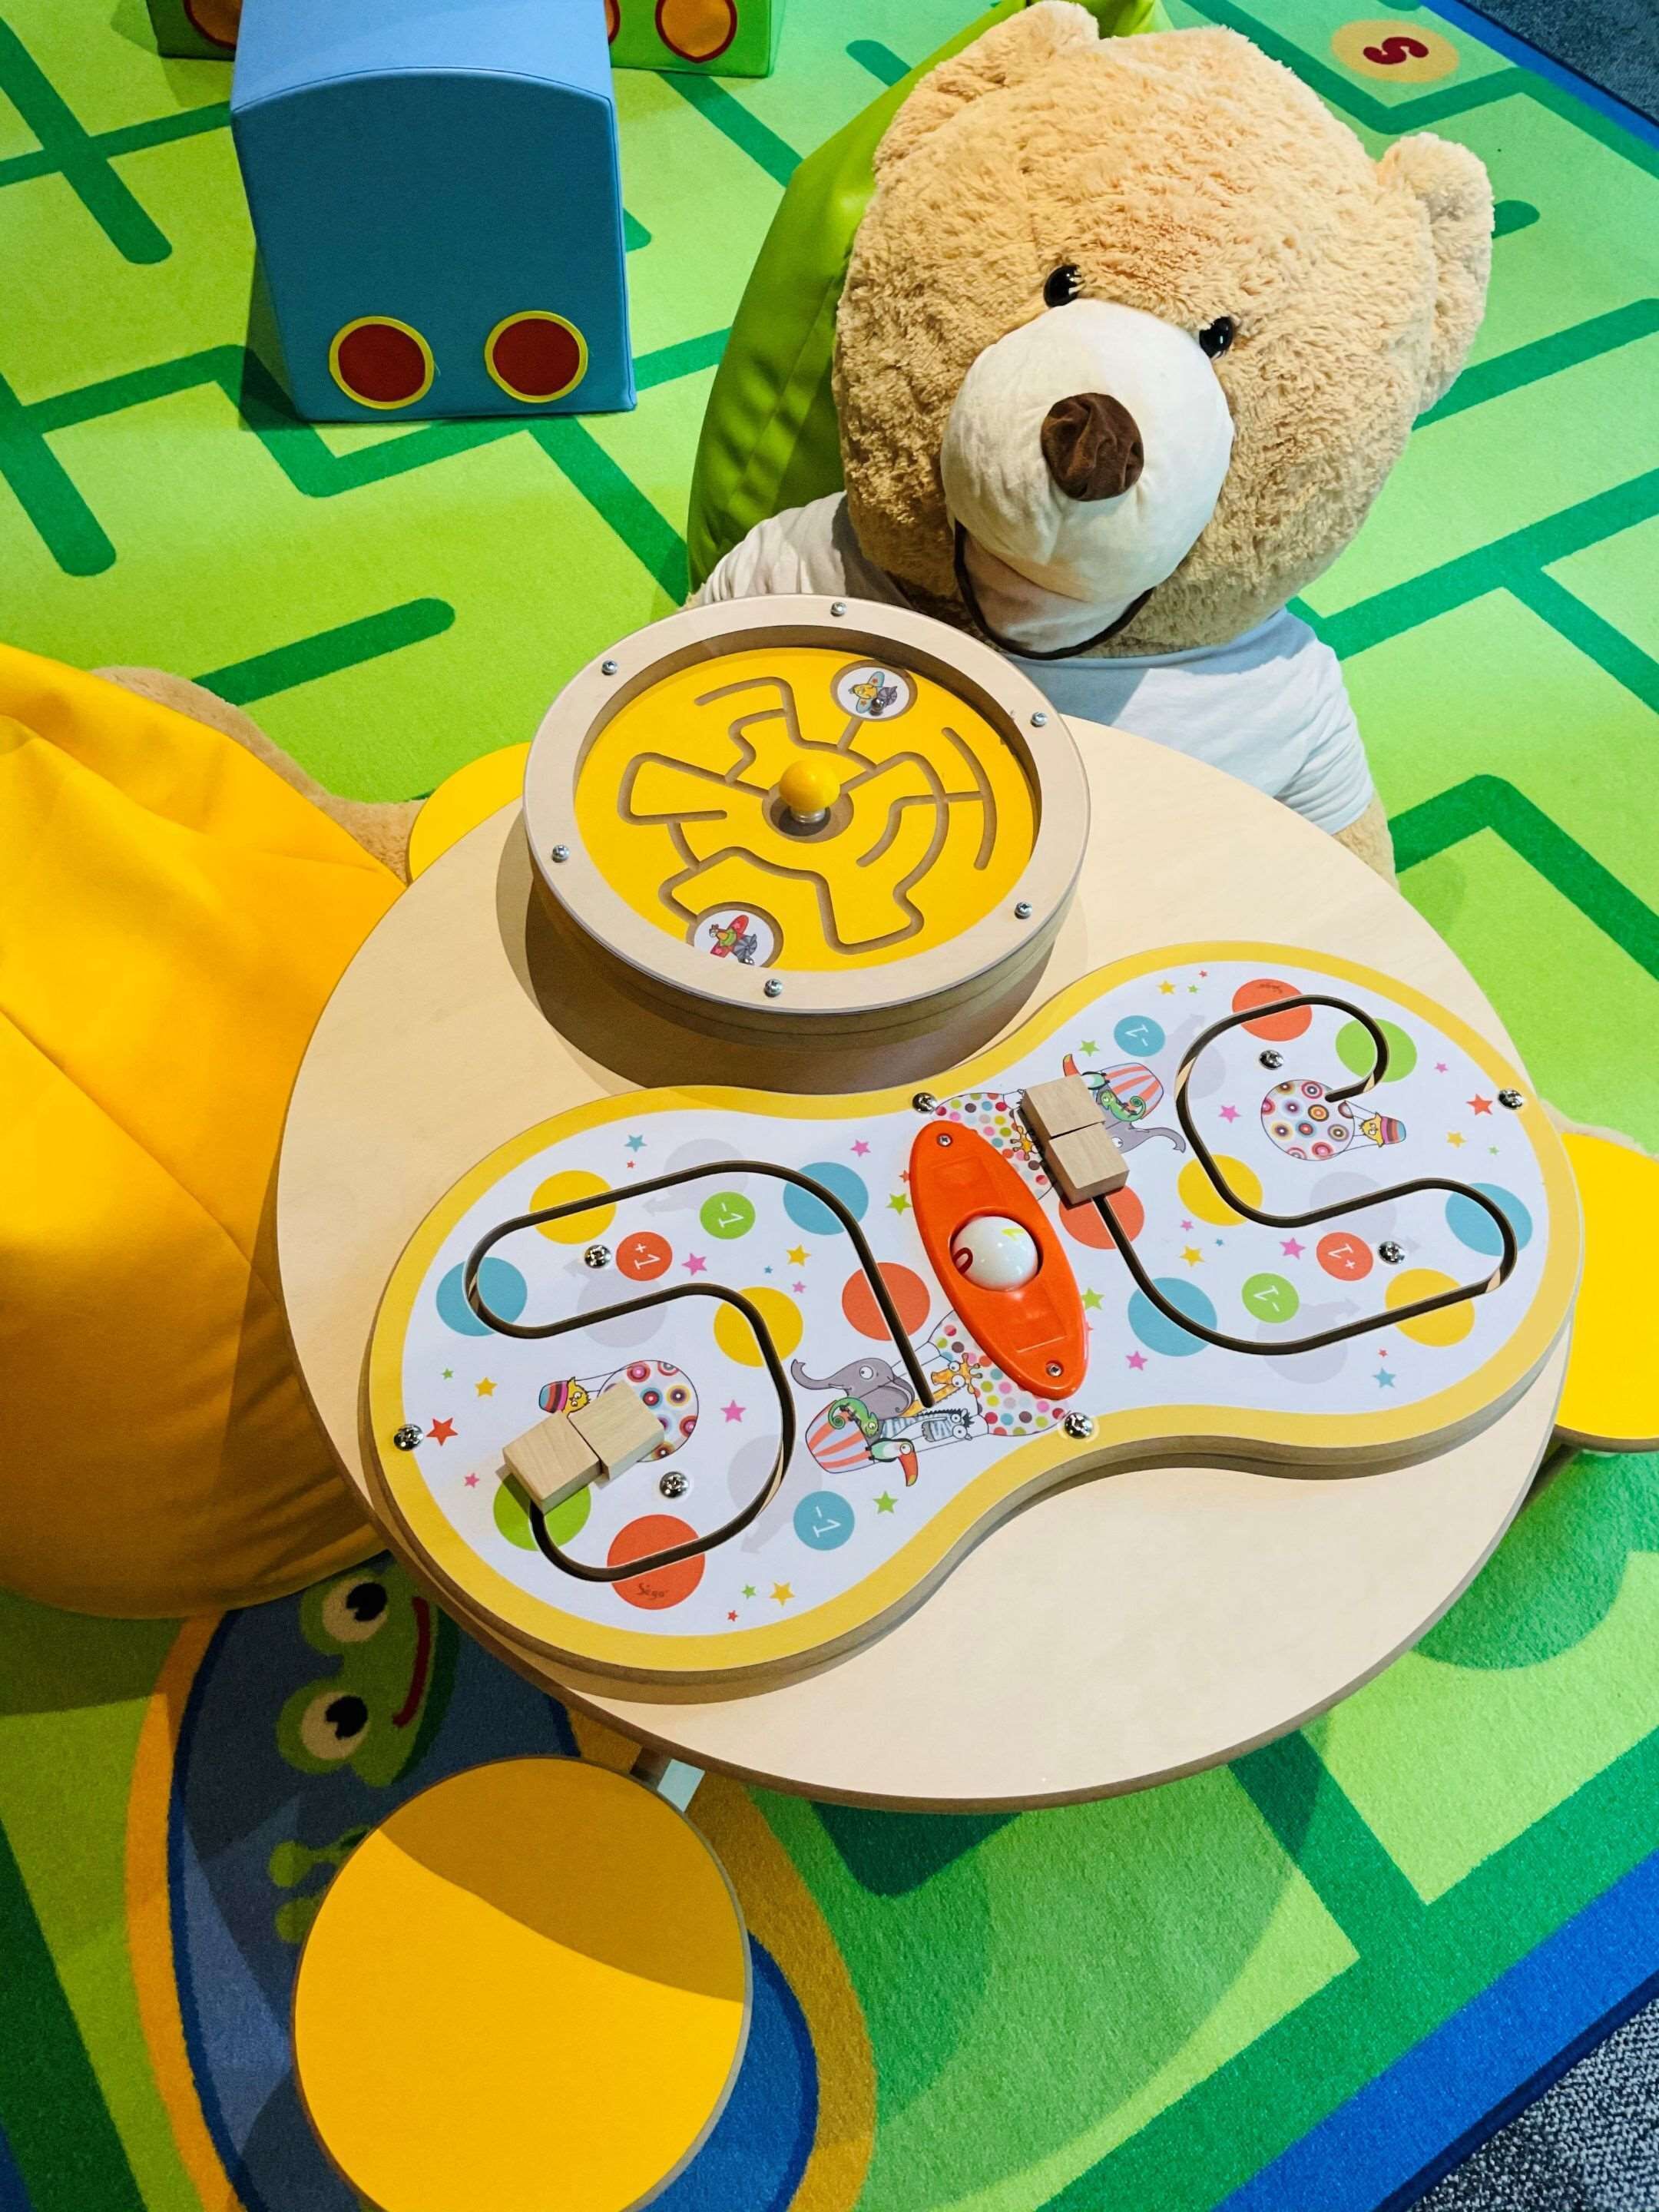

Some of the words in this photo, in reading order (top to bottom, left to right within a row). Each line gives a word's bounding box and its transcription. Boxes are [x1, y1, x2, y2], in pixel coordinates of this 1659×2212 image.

[719, 1202, 745, 1229] -1
[634, 1242, 661, 1270] +1
[1328, 1243, 1356, 1270] +1
[1253, 1284, 1280, 1312] -1
[813, 1505, 842, 1538] -1
